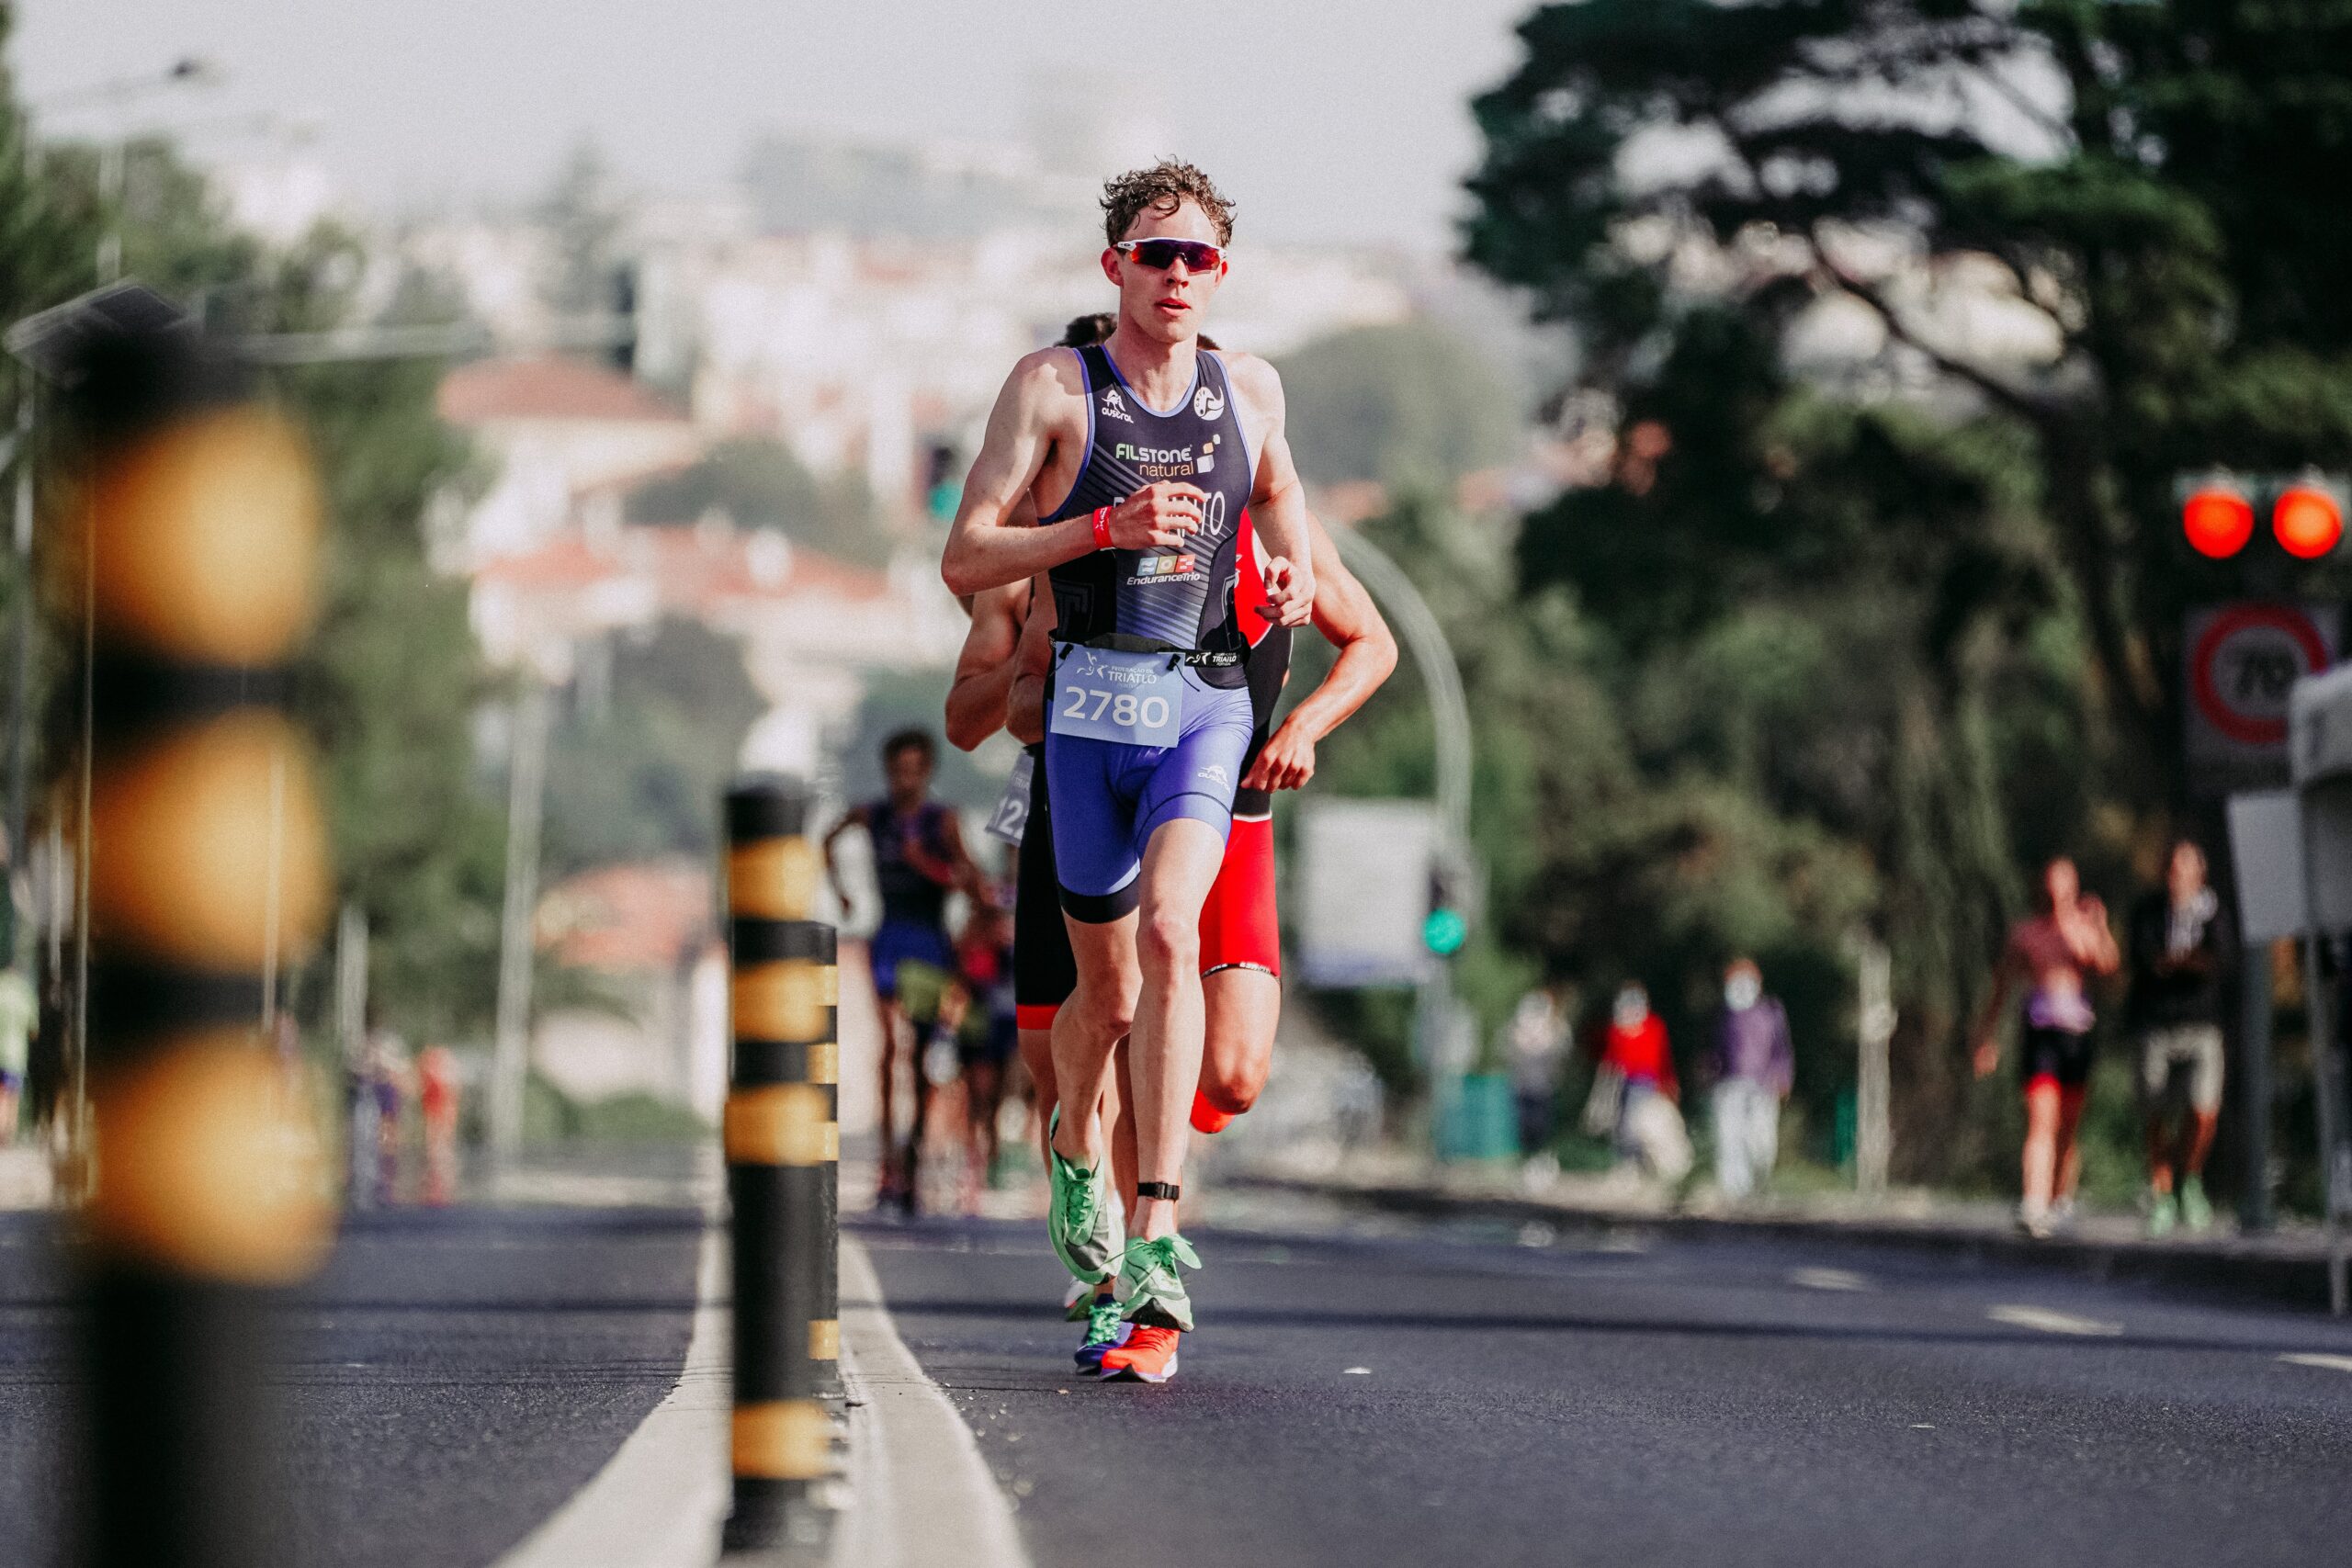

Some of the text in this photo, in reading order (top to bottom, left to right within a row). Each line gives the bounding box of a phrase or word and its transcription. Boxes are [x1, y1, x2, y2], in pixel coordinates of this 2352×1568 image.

[1102, 407, 1134, 423] austral
[1115, 443, 1193, 463] FILSTONE
[1139, 463, 1194, 478] natural
[1126, 573, 1201, 586] EnduranceTrio
[1107, 671, 1157, 684] TRIATLO
[1063, 686, 1170, 728] 2780
